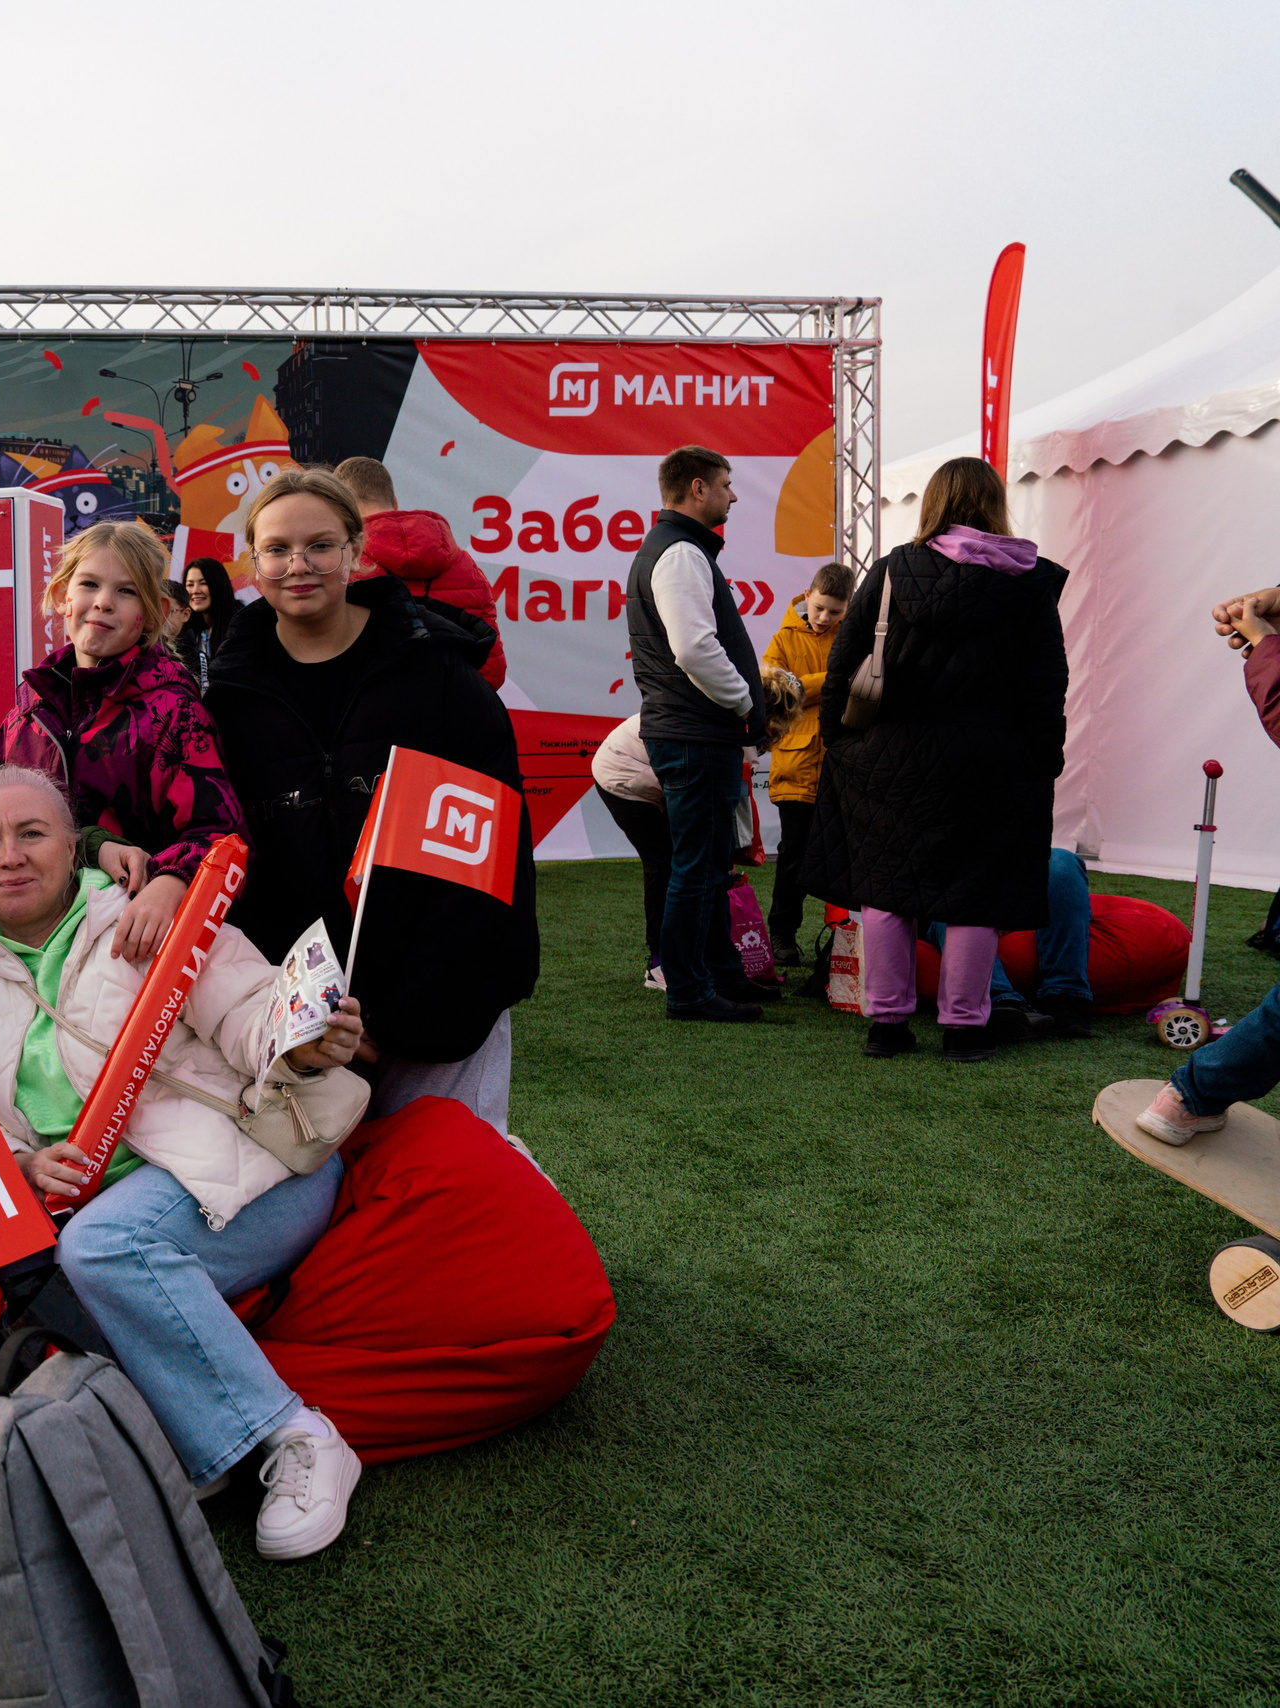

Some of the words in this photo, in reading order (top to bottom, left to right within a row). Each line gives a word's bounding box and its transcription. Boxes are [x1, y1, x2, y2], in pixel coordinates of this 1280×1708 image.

[614, 374, 775, 406] МАГНИТ
[470, 494, 725, 554] Забе
[540, 739, 579, 748] Нижний
[743, 962, 764, 972] 2025
[308, 1010, 316, 1019] 2
[138, 987, 183, 1067] РАБОТАЙ
[131, 1068, 145, 1082] В
